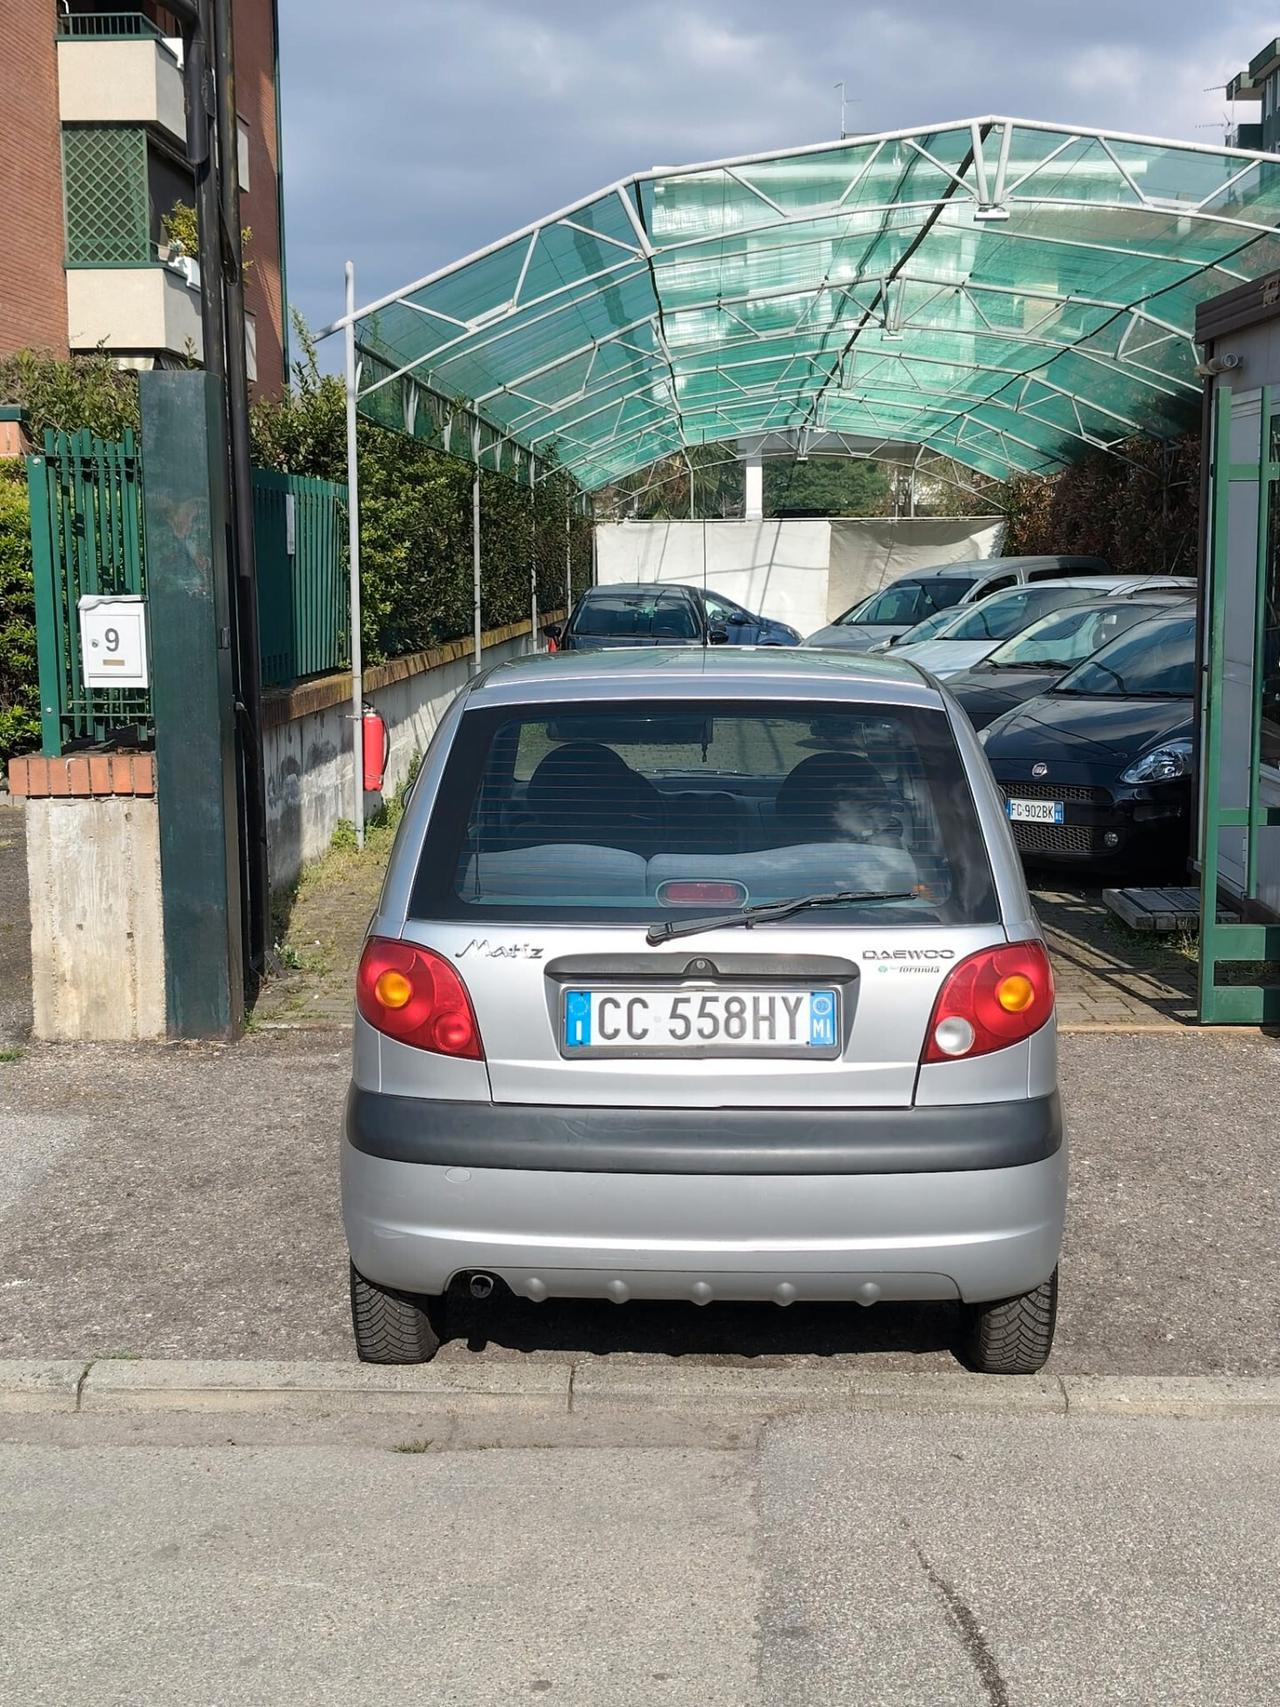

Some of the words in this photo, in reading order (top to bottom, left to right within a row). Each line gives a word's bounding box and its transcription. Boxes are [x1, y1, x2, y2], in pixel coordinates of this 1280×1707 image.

[104, 627, 120, 652] 9
[1024, 804, 1054, 819] 902BK
[454, 938, 544, 959] Matiz
[862, 949, 956, 960] DAEWOO
[598, 996, 649, 1041] CC
[668, 995, 804, 1041] 558HY
[812, 1018, 832, 1039] MI
